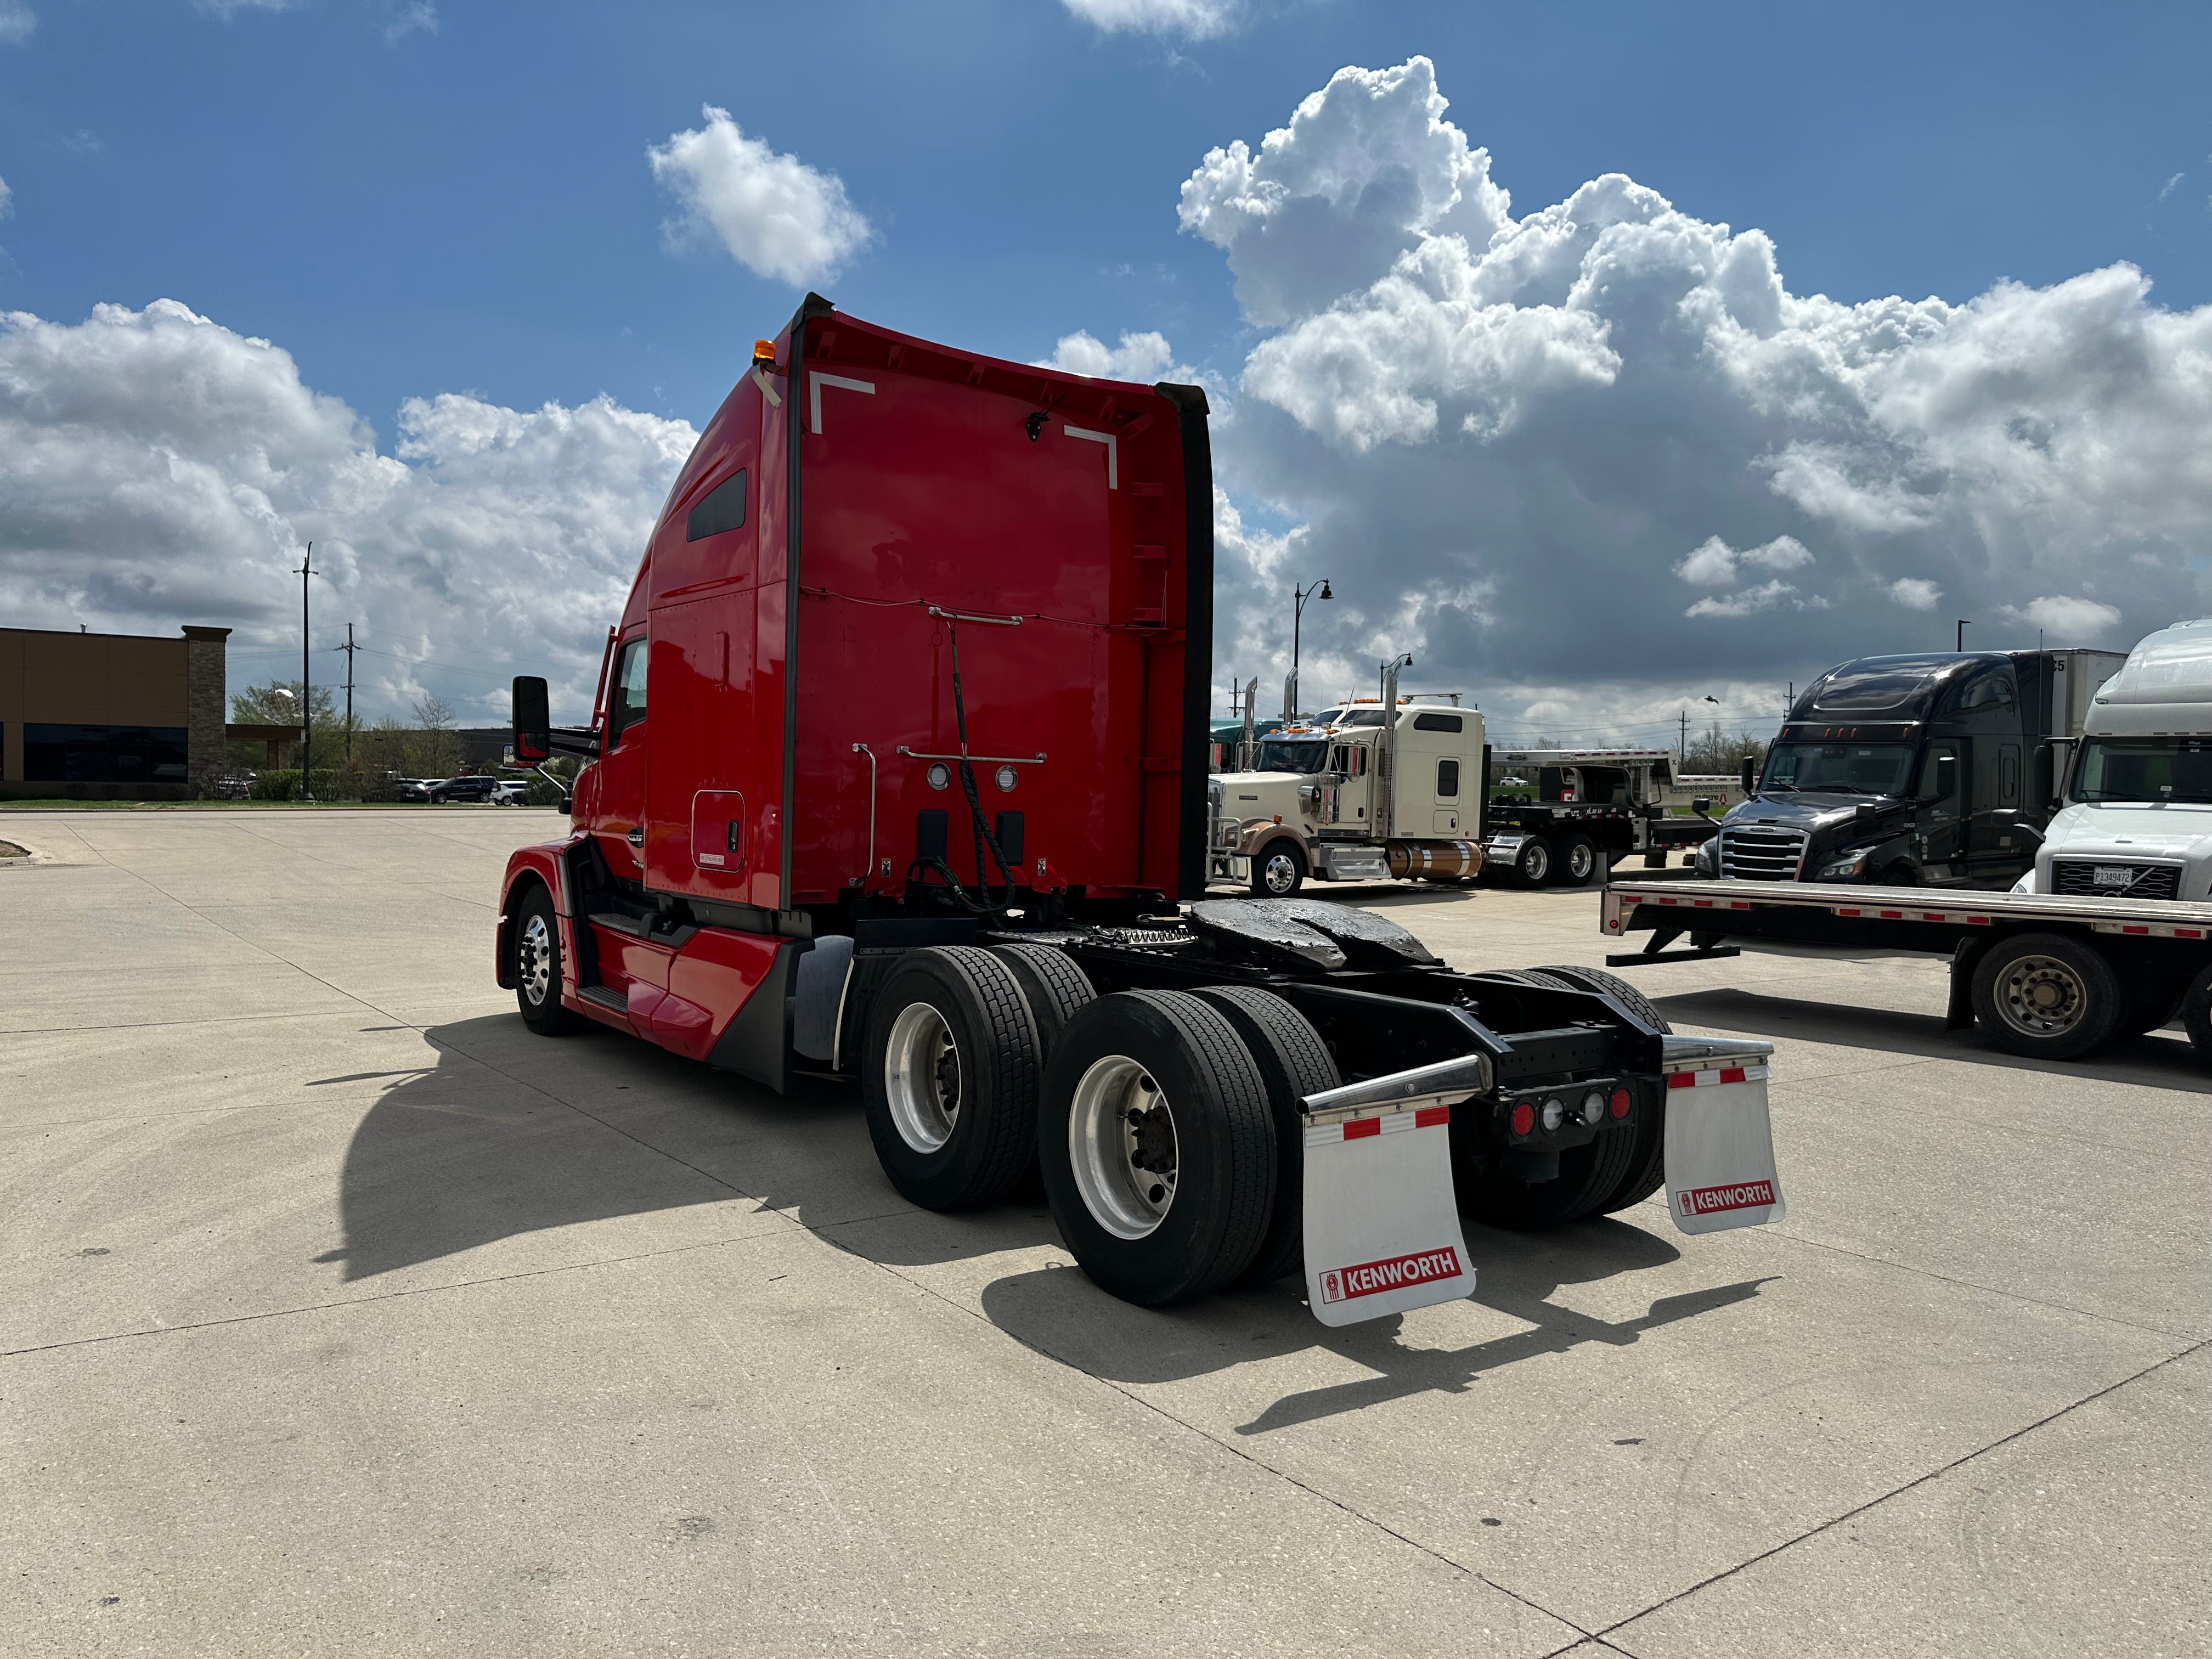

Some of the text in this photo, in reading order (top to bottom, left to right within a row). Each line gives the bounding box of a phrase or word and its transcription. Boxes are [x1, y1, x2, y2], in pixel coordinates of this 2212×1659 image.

[2095, 872, 2130, 882] P1349472
[1696, 1184, 1771, 1209] KENWORTH
[1347, 1252, 1455, 1293] KENWORTH
